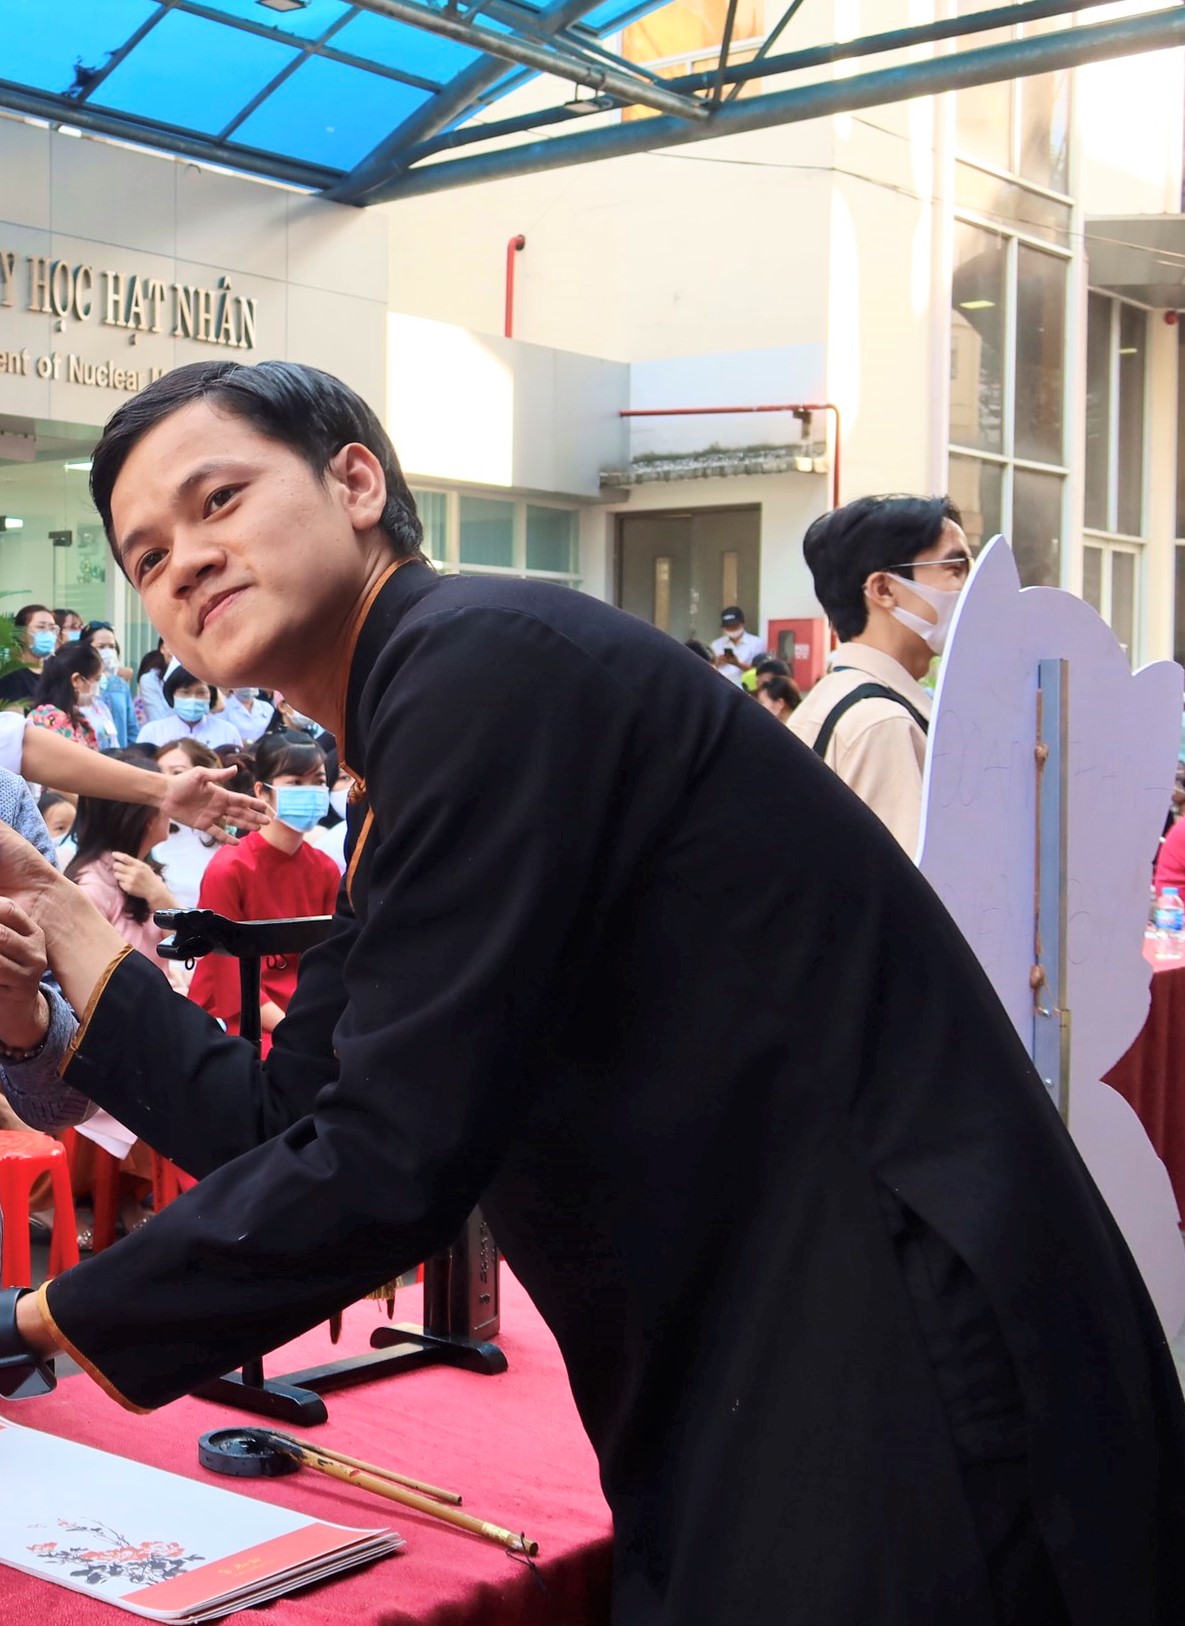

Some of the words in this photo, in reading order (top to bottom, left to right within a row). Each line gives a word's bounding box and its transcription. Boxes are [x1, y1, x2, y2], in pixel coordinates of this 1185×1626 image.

[26, 256, 93, 333] HỌC
[101, 270, 167, 346] HẠT
[170, 275, 259, 350] NHÂN
[36, 351, 61, 380] of
[66, 353, 146, 392] Nuclear
